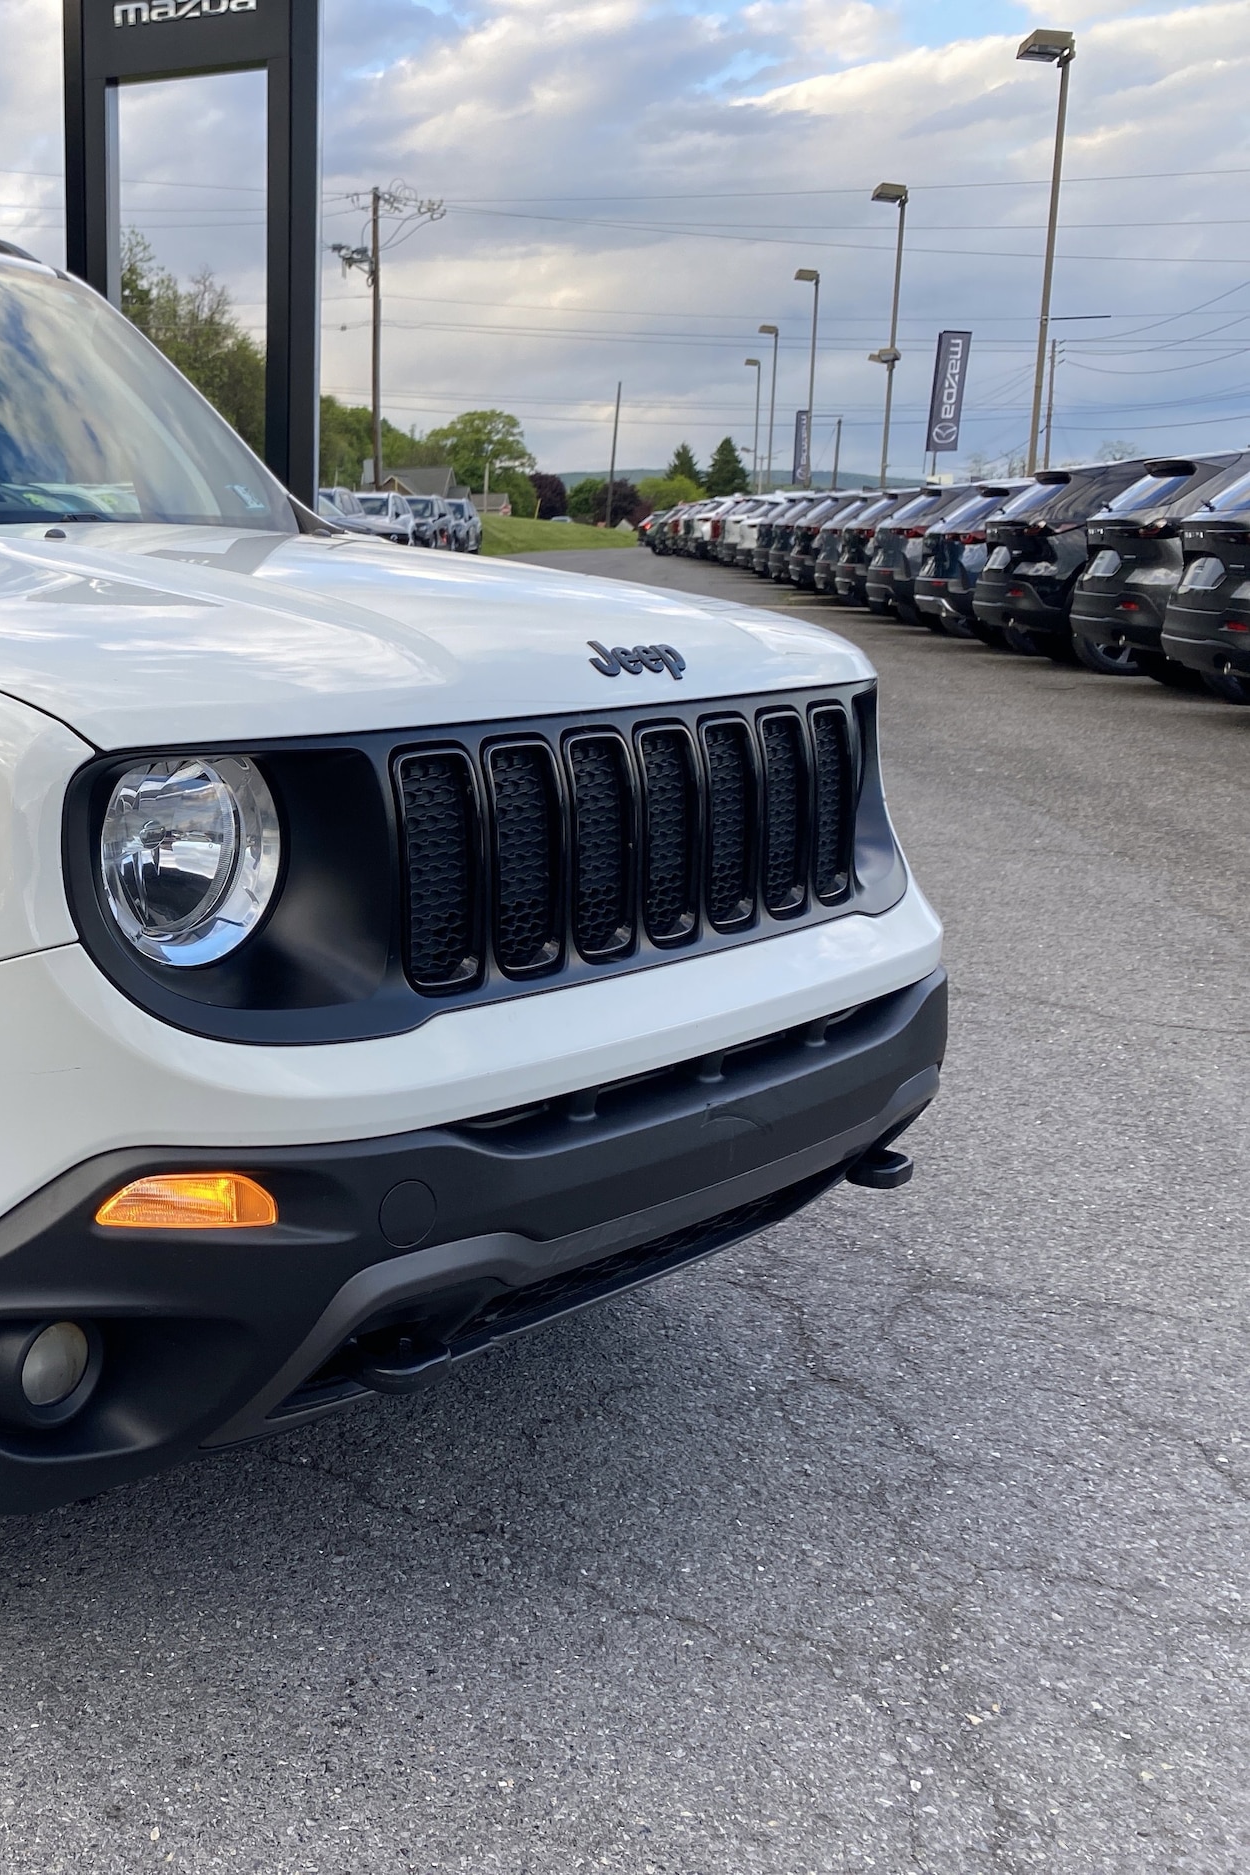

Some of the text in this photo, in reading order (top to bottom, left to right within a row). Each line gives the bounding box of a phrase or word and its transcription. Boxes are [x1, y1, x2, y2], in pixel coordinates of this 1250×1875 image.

[113, 0, 257, 28] mazda
[941, 338, 963, 419] mazda
[586, 640, 686, 681] Jeep
